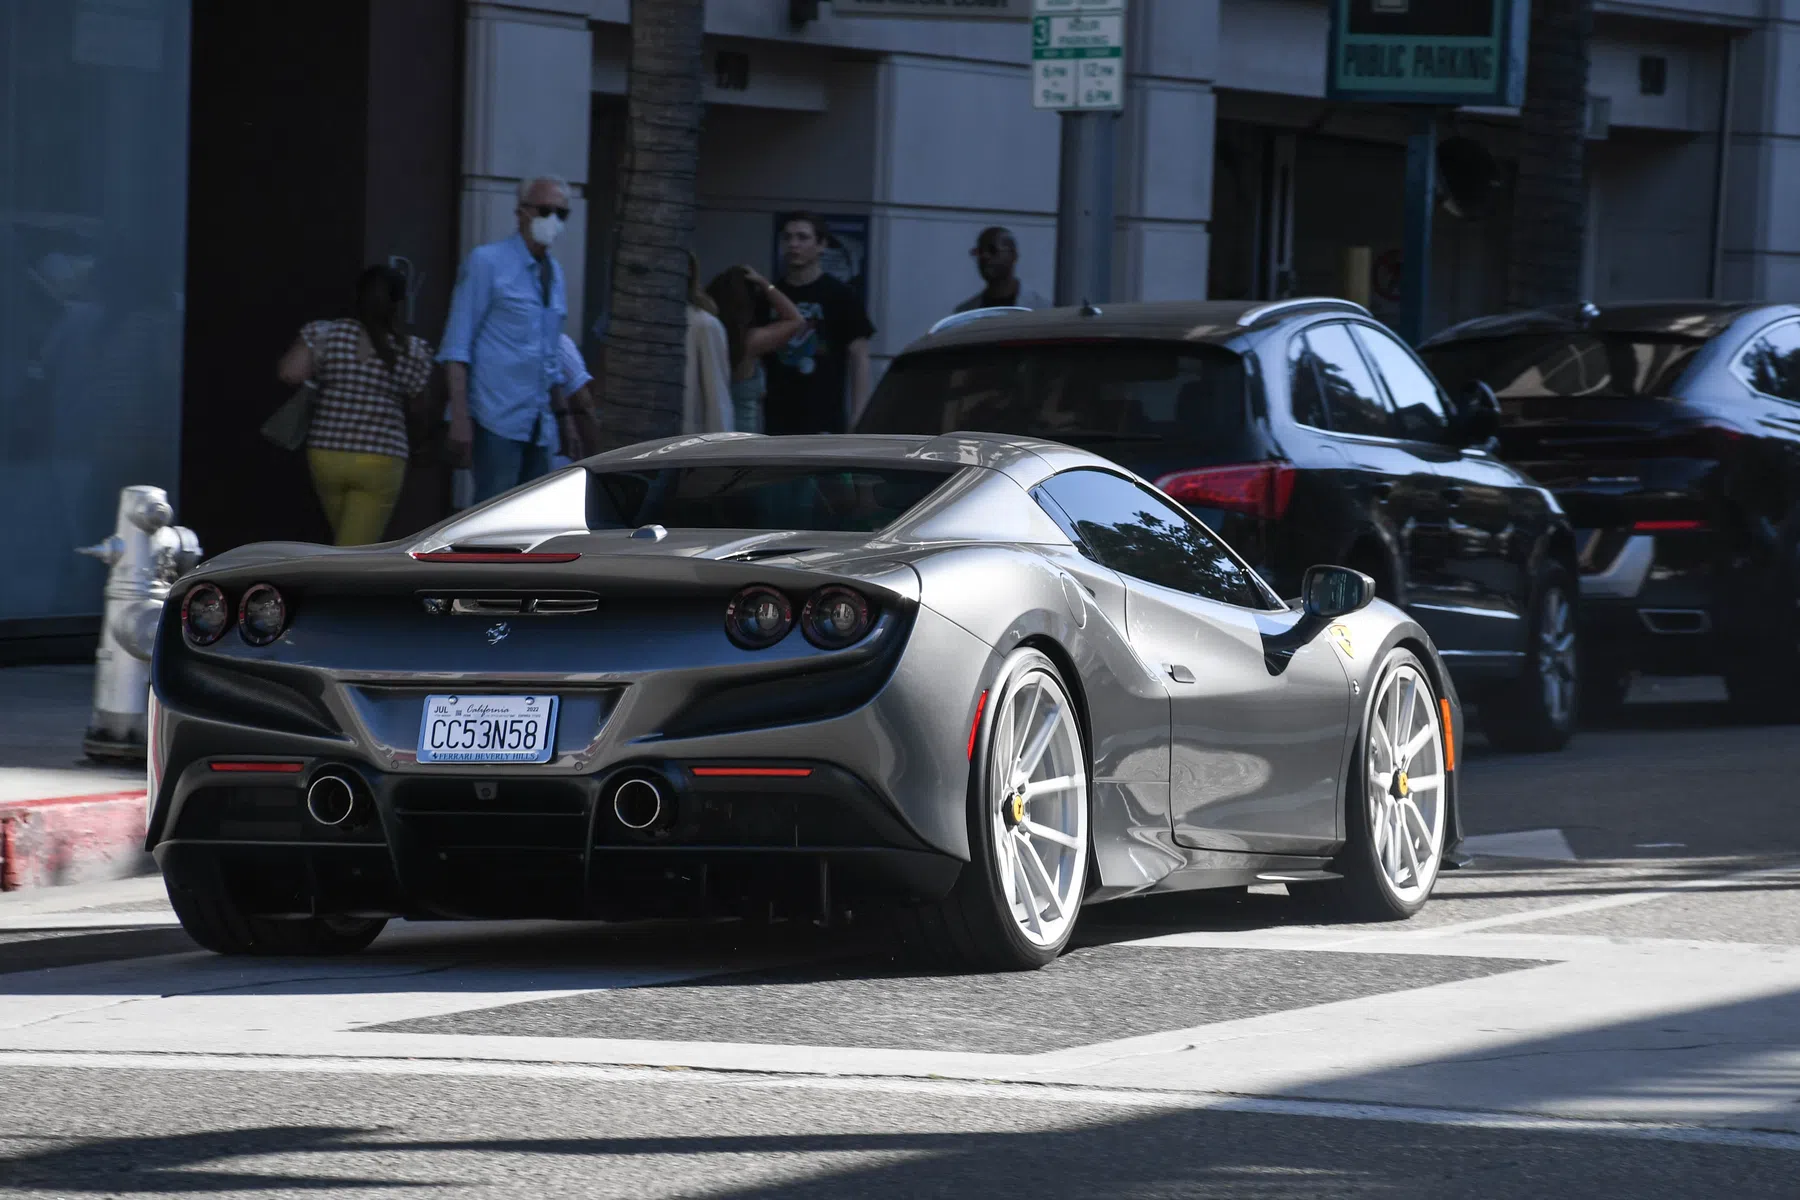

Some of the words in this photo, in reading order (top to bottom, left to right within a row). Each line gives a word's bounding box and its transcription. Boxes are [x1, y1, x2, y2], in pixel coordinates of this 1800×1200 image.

[1035, 19, 1047, 44] 3
[1343, 43, 1405, 77] PUBLIC
[1412, 44, 1494, 79] PARKING
[467, 704, 509, 717] California
[430, 719, 538, 749] CC53N58
[439, 752, 473, 760] FERRARI
[475, 752, 511, 760] BEVERLY
[512, 752, 536, 760] HILLS
